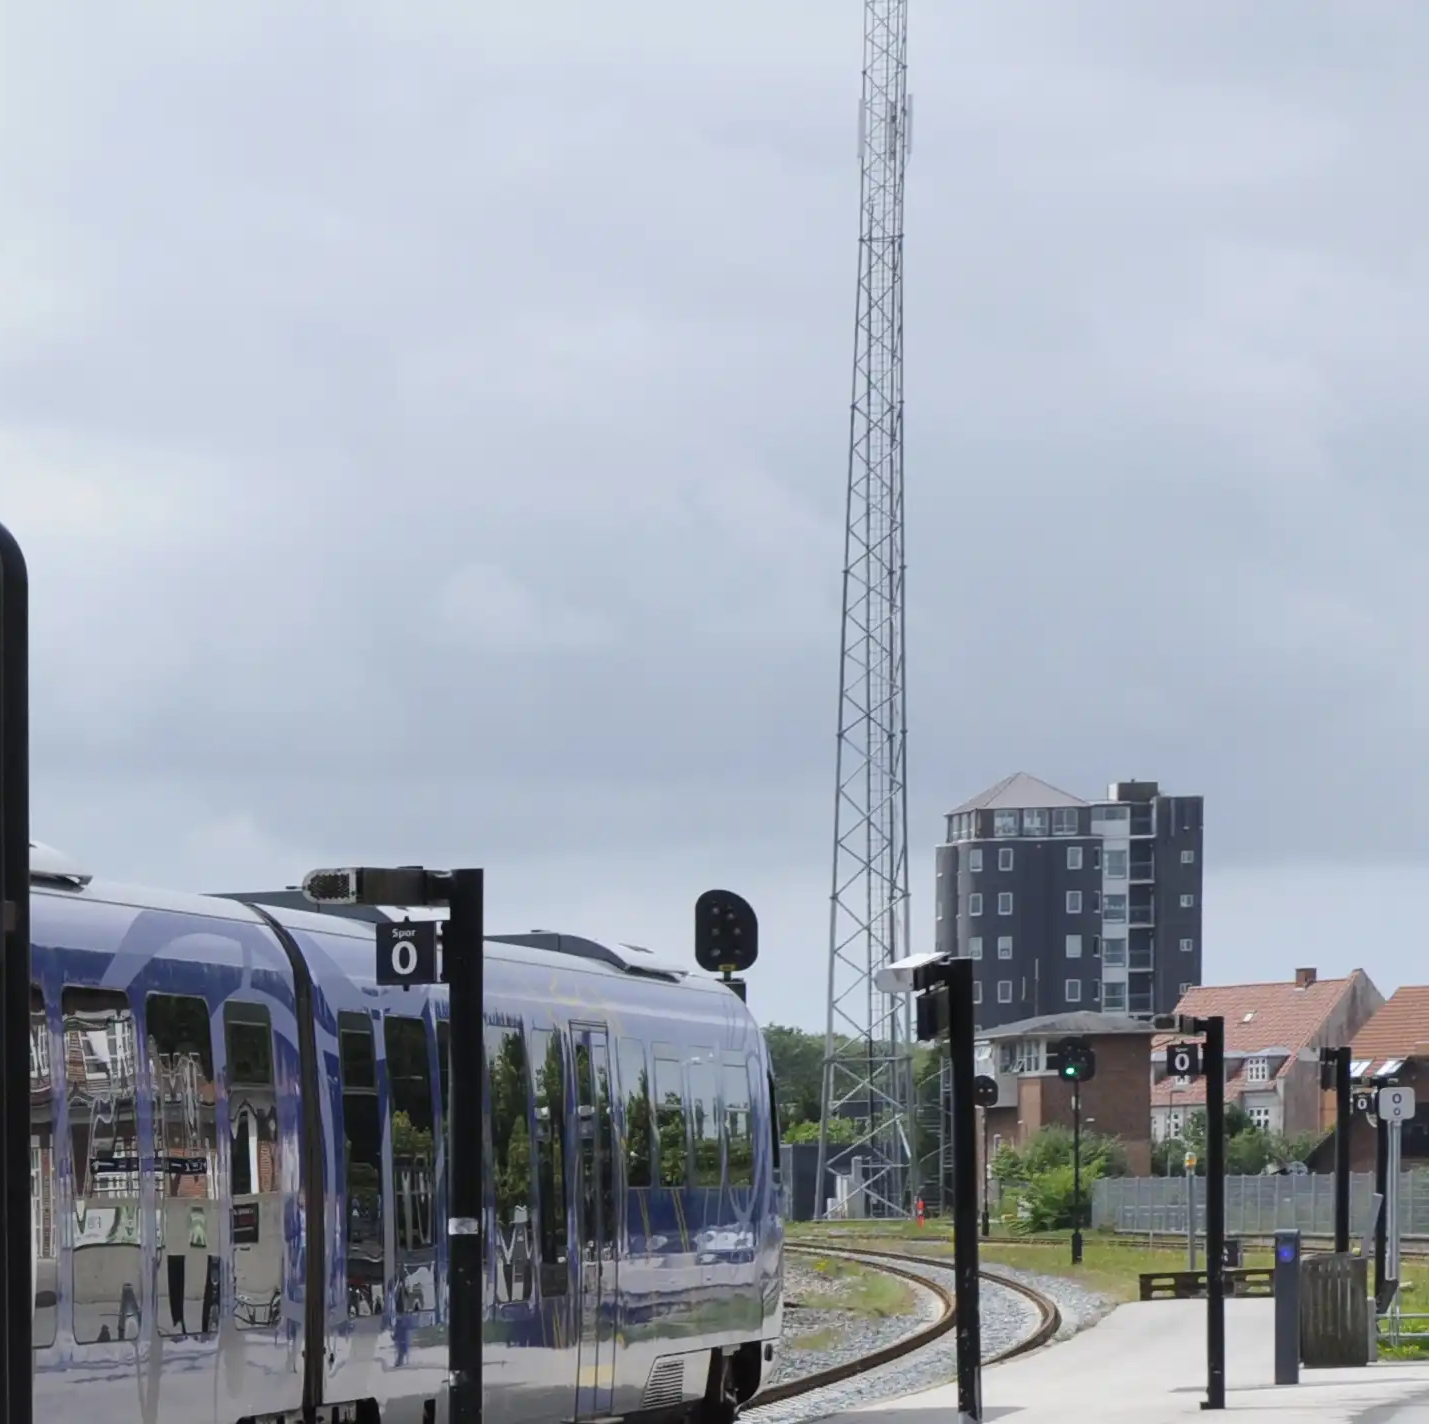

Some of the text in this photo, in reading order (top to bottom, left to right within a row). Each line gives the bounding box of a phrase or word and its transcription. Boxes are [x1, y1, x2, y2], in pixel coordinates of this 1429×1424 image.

[392, 928, 416, 939] Spor
[391, 941, 417, 975] 0
[1175, 1053, 1189, 1070] 0
